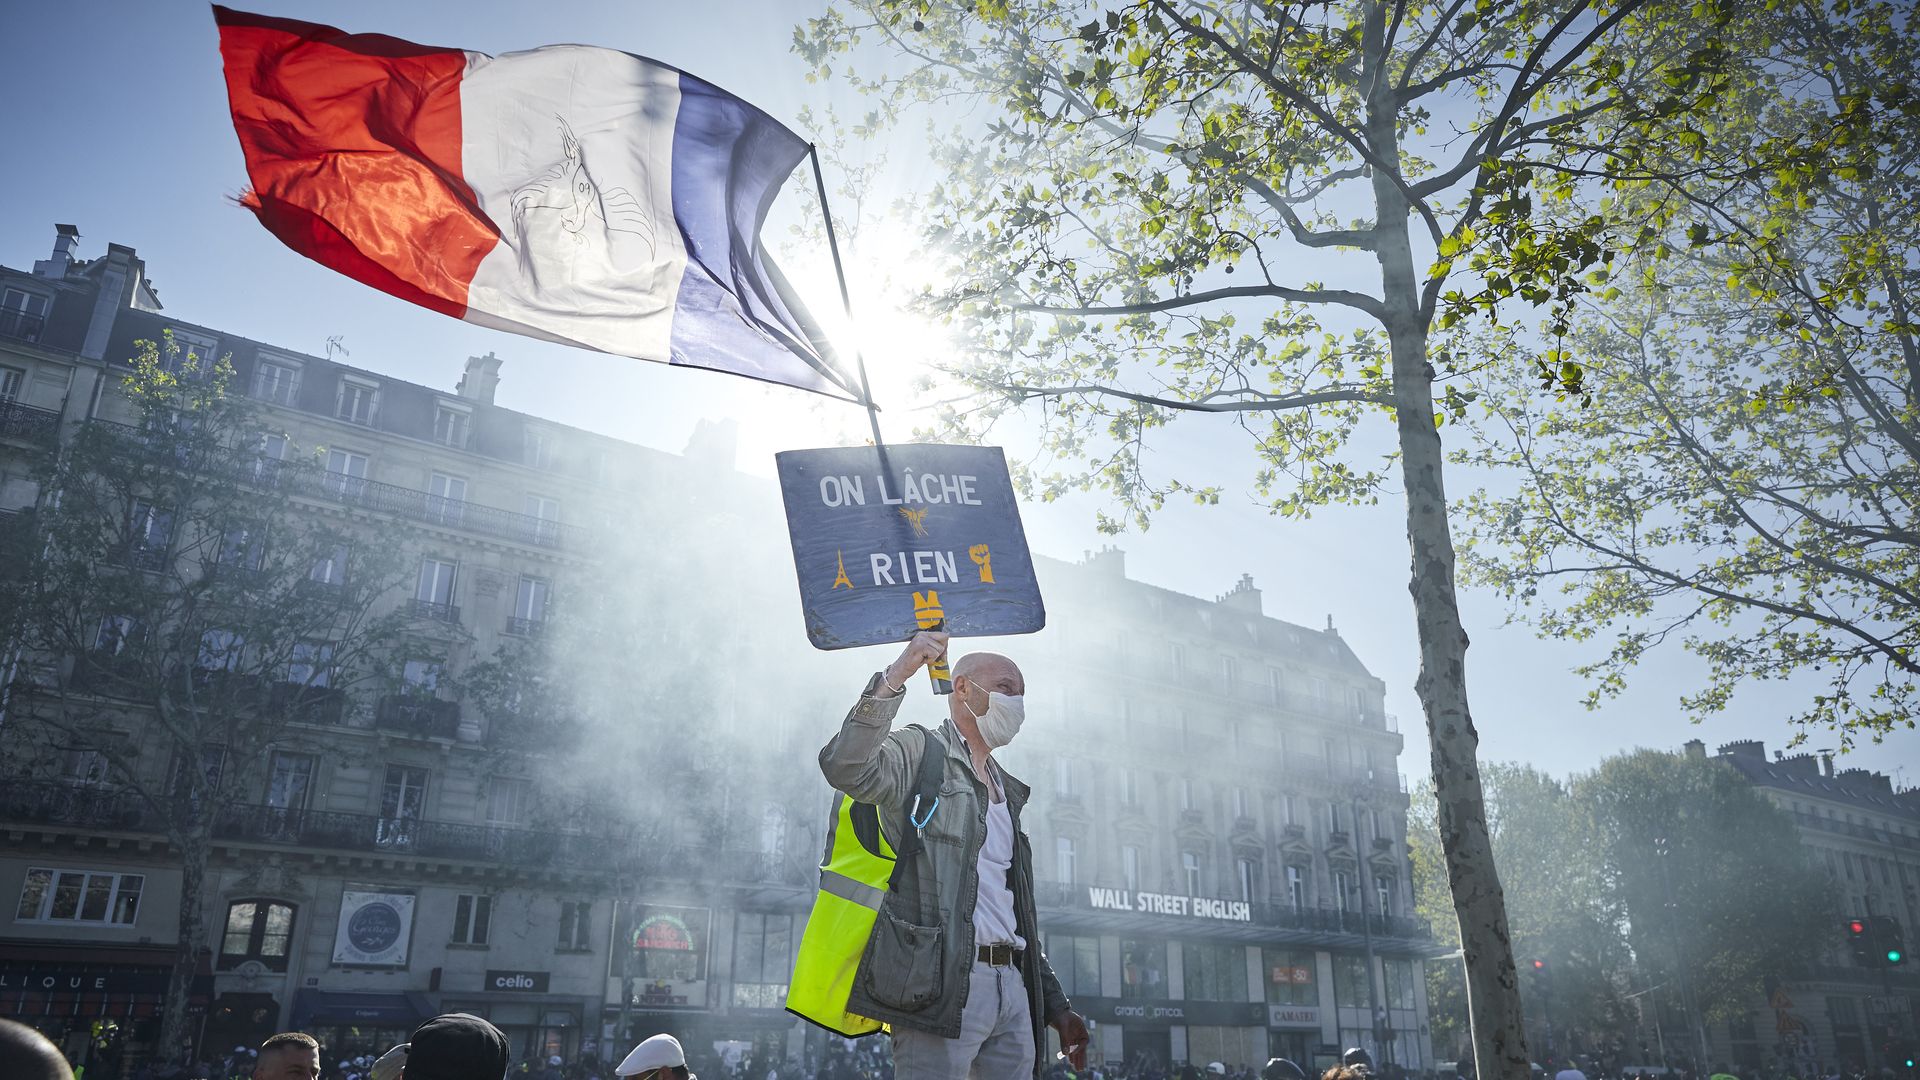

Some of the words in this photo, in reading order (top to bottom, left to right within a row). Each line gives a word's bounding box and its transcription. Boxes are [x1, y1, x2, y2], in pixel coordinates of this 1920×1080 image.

[819, 474, 865, 508] ON
[878, 467, 982, 506] LÂCHE
[870, 551, 959, 585] RIEN
[1089, 887, 1132, 911] WALL
[1137, 892, 1189, 916] STREET
[1193, 897, 1250, 922] ENGLISH
[496, 973, 534, 989] celio
